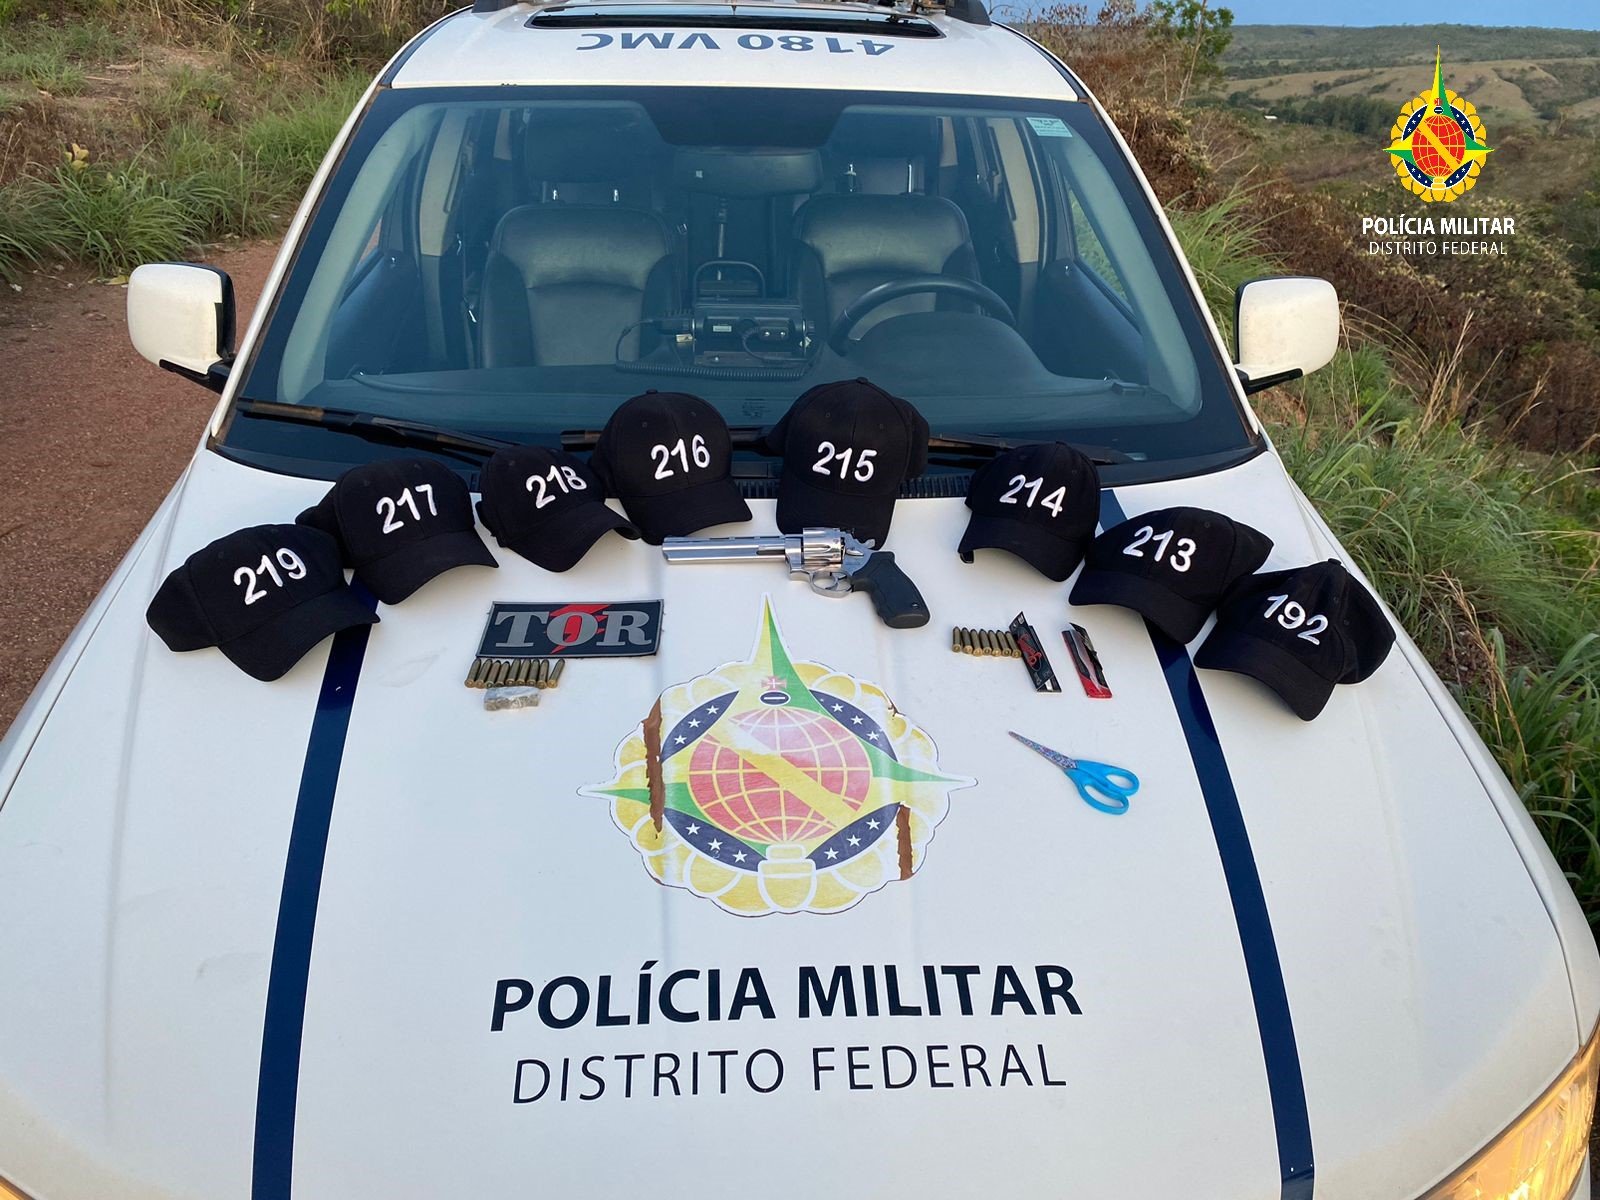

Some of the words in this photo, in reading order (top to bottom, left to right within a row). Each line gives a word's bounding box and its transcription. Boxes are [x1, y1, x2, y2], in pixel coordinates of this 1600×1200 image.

[576, 32, 721, 51] VMC
[736, 35, 896, 56] 4180
[650, 433, 711, 480] 216
[812, 440, 879, 483] 215
[375, 482, 439, 534] 217
[525, 464, 588, 510] 218
[999, 473, 1067, 518] 214
[1122, 524, 1198, 573] 213
[232, 546, 308, 606] 219
[494, 610, 652, 648] TOR
[1262, 593, 1330, 646] 192
[490, 960, 777, 1032] POLÍCIA
[798, 964, 1083, 1019] MILITAR
[513, 1048, 785, 1104] DISTRITO
[812, 1044, 1067, 1091] FEDERAL
